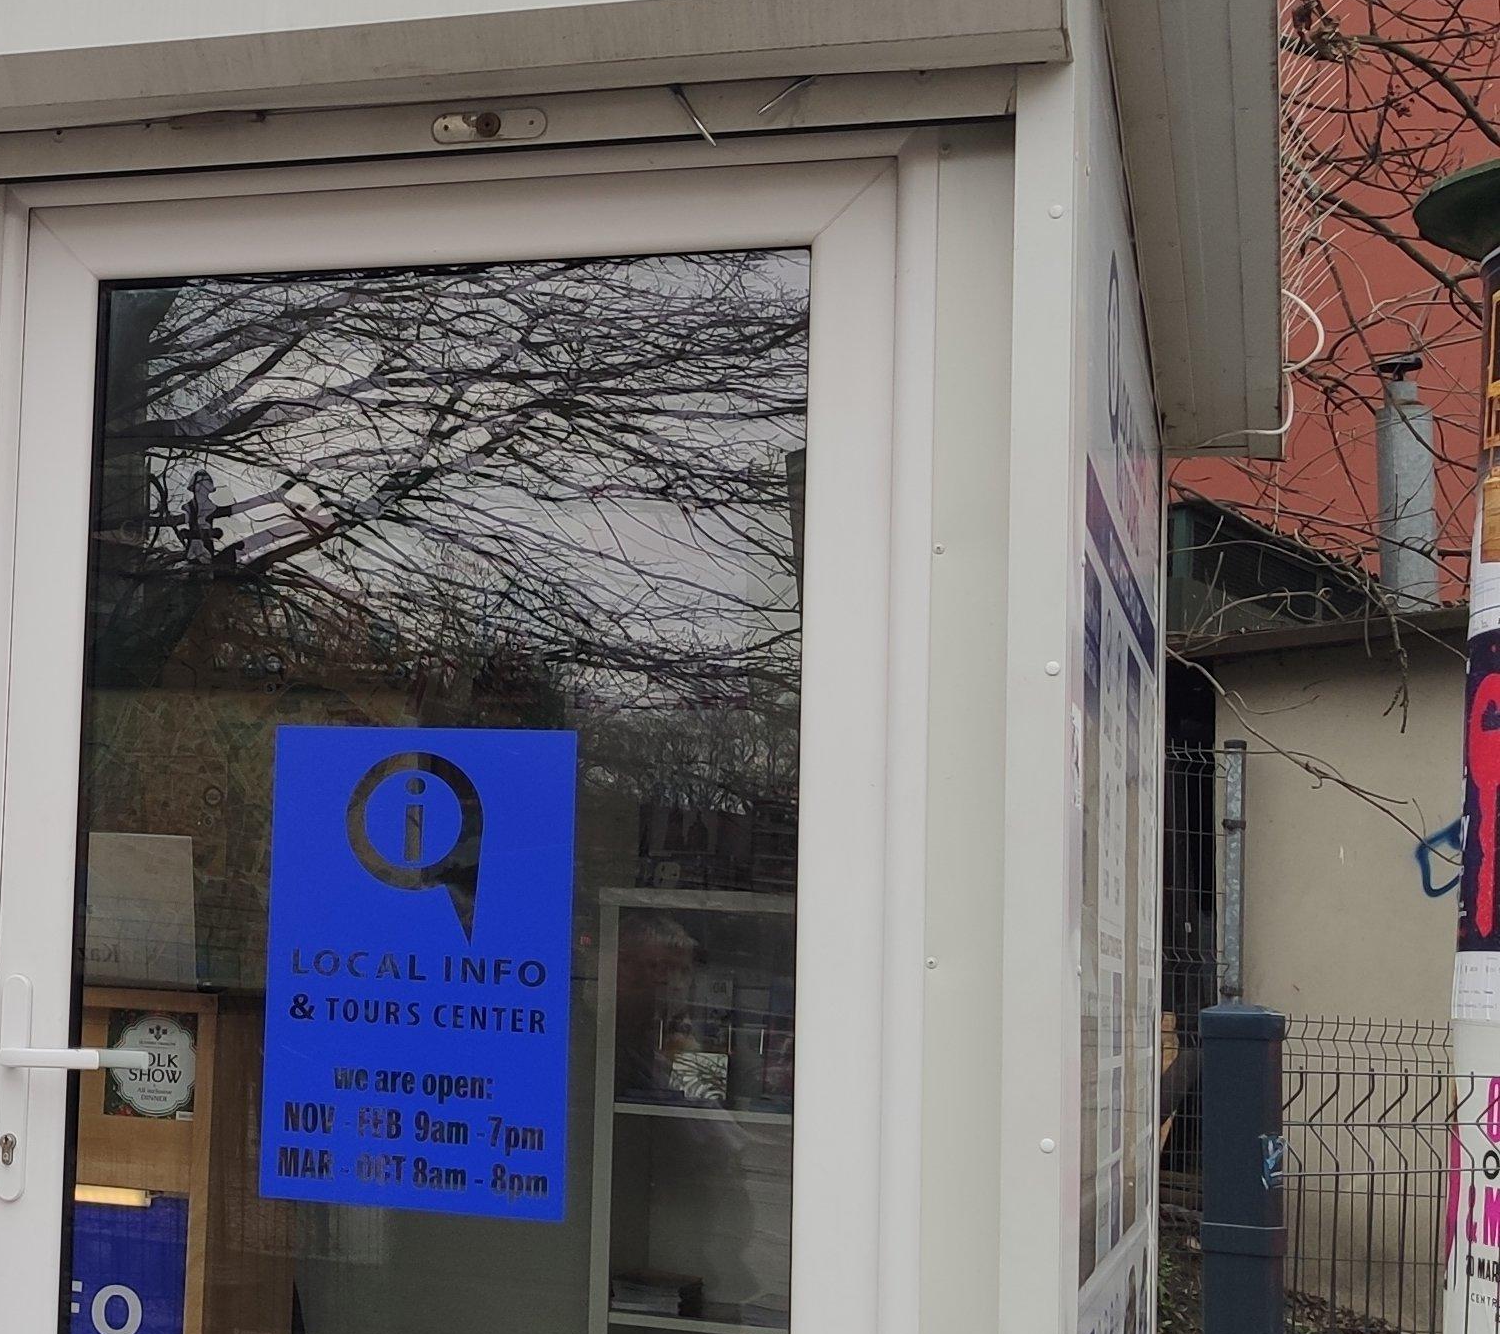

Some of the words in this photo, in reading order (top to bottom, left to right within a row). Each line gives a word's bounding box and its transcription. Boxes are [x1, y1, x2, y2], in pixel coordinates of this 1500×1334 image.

[291, 948, 427, 981] LOCAL
[443, 955, 547, 988] INFO
[289, 993, 315, 1021] &
[325, 997, 420, 1026] TOURS
[433, 1004, 546, 1034] CENTER
[128, 1068, 182, 1083] SHOW
[148, 1052, 178, 1068] OLK
[375, 1069, 415, 1095] are
[422, 1073, 494, 1104] open:
[284, 1101, 335, 1134] NOV
[357, 1106, 402, 1140] FEB
[414, 1110, 469, 1145] 9am
[278, 1146, 333, 1180] MAR
[356, 1153, 406, 1184] OCT
[412, 1157, 467, 1190] 8am
[490, 1163, 548, 1203] 8pm
